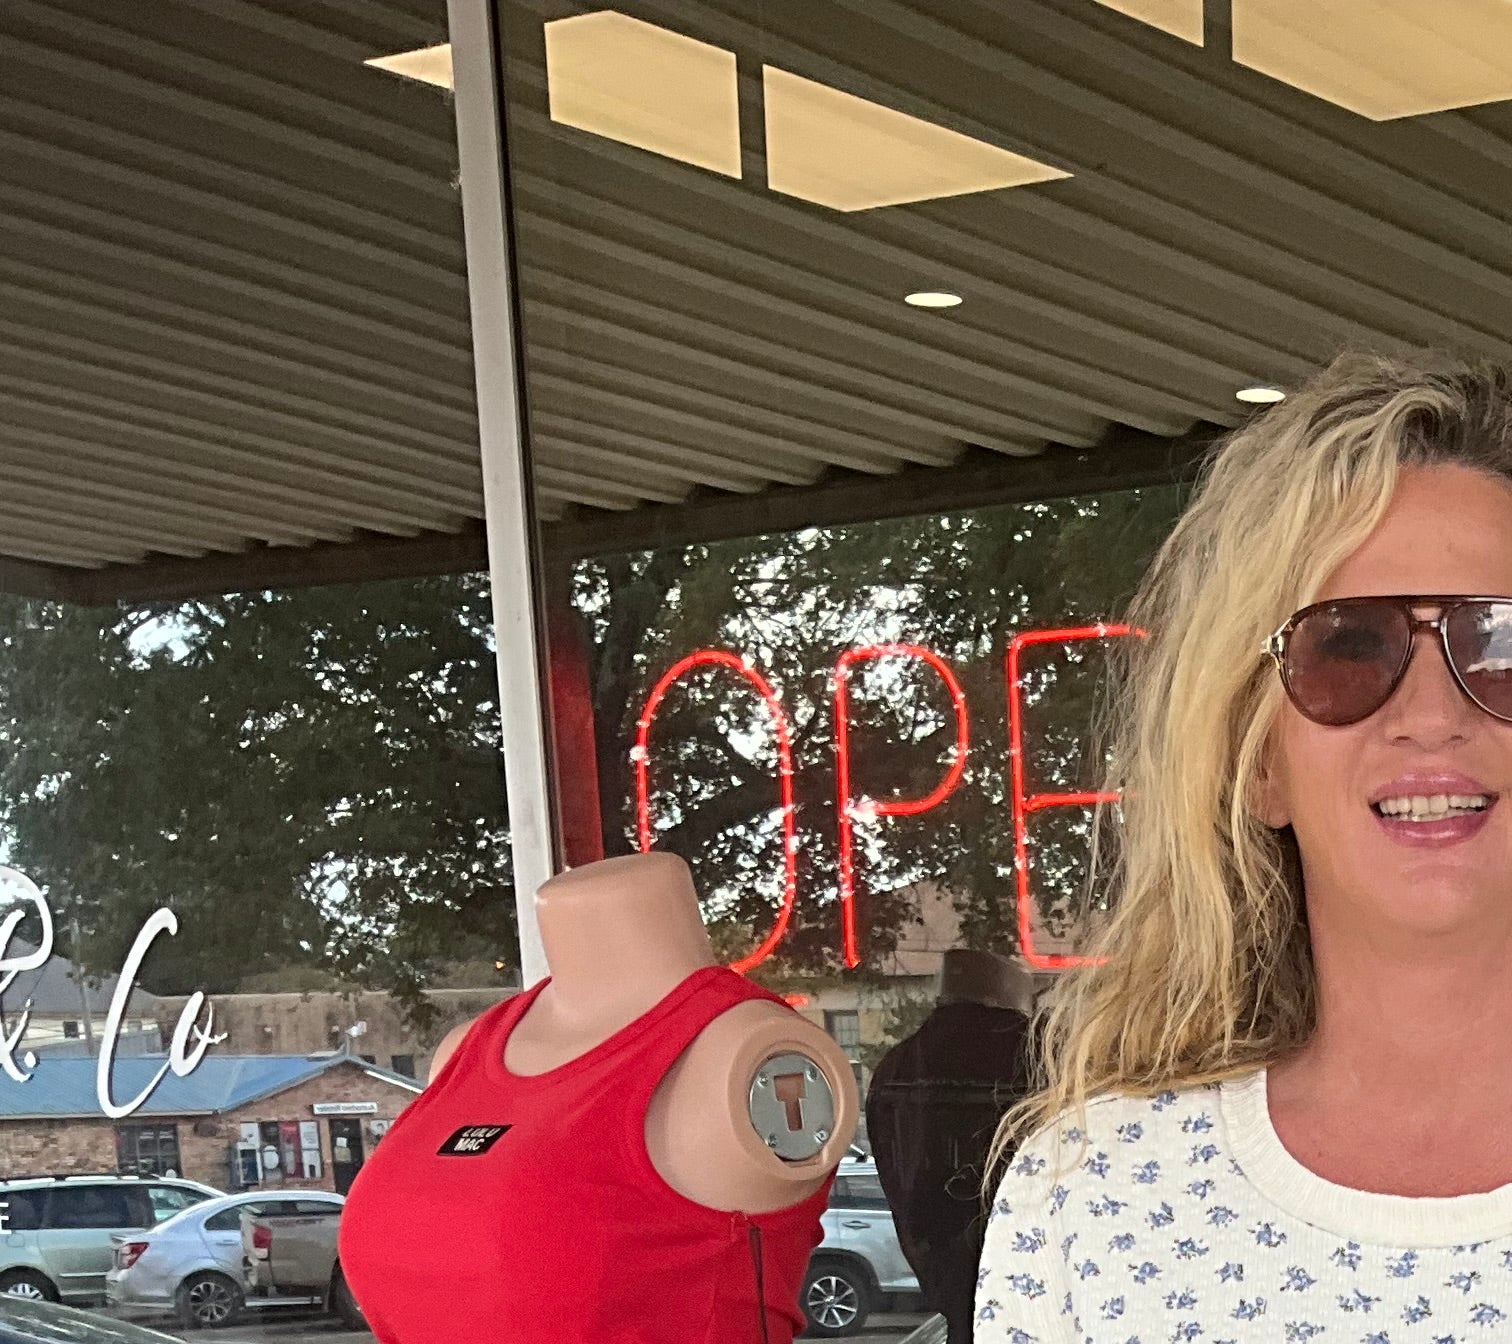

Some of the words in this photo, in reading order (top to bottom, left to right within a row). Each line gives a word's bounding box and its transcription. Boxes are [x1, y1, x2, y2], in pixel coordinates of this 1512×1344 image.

[636, 624, 1152, 976] OPE
[97, 907, 228, 1119] Co
[453, 1137, 485, 1152] MAC
[461, 1127, 501, 1138] LULU
